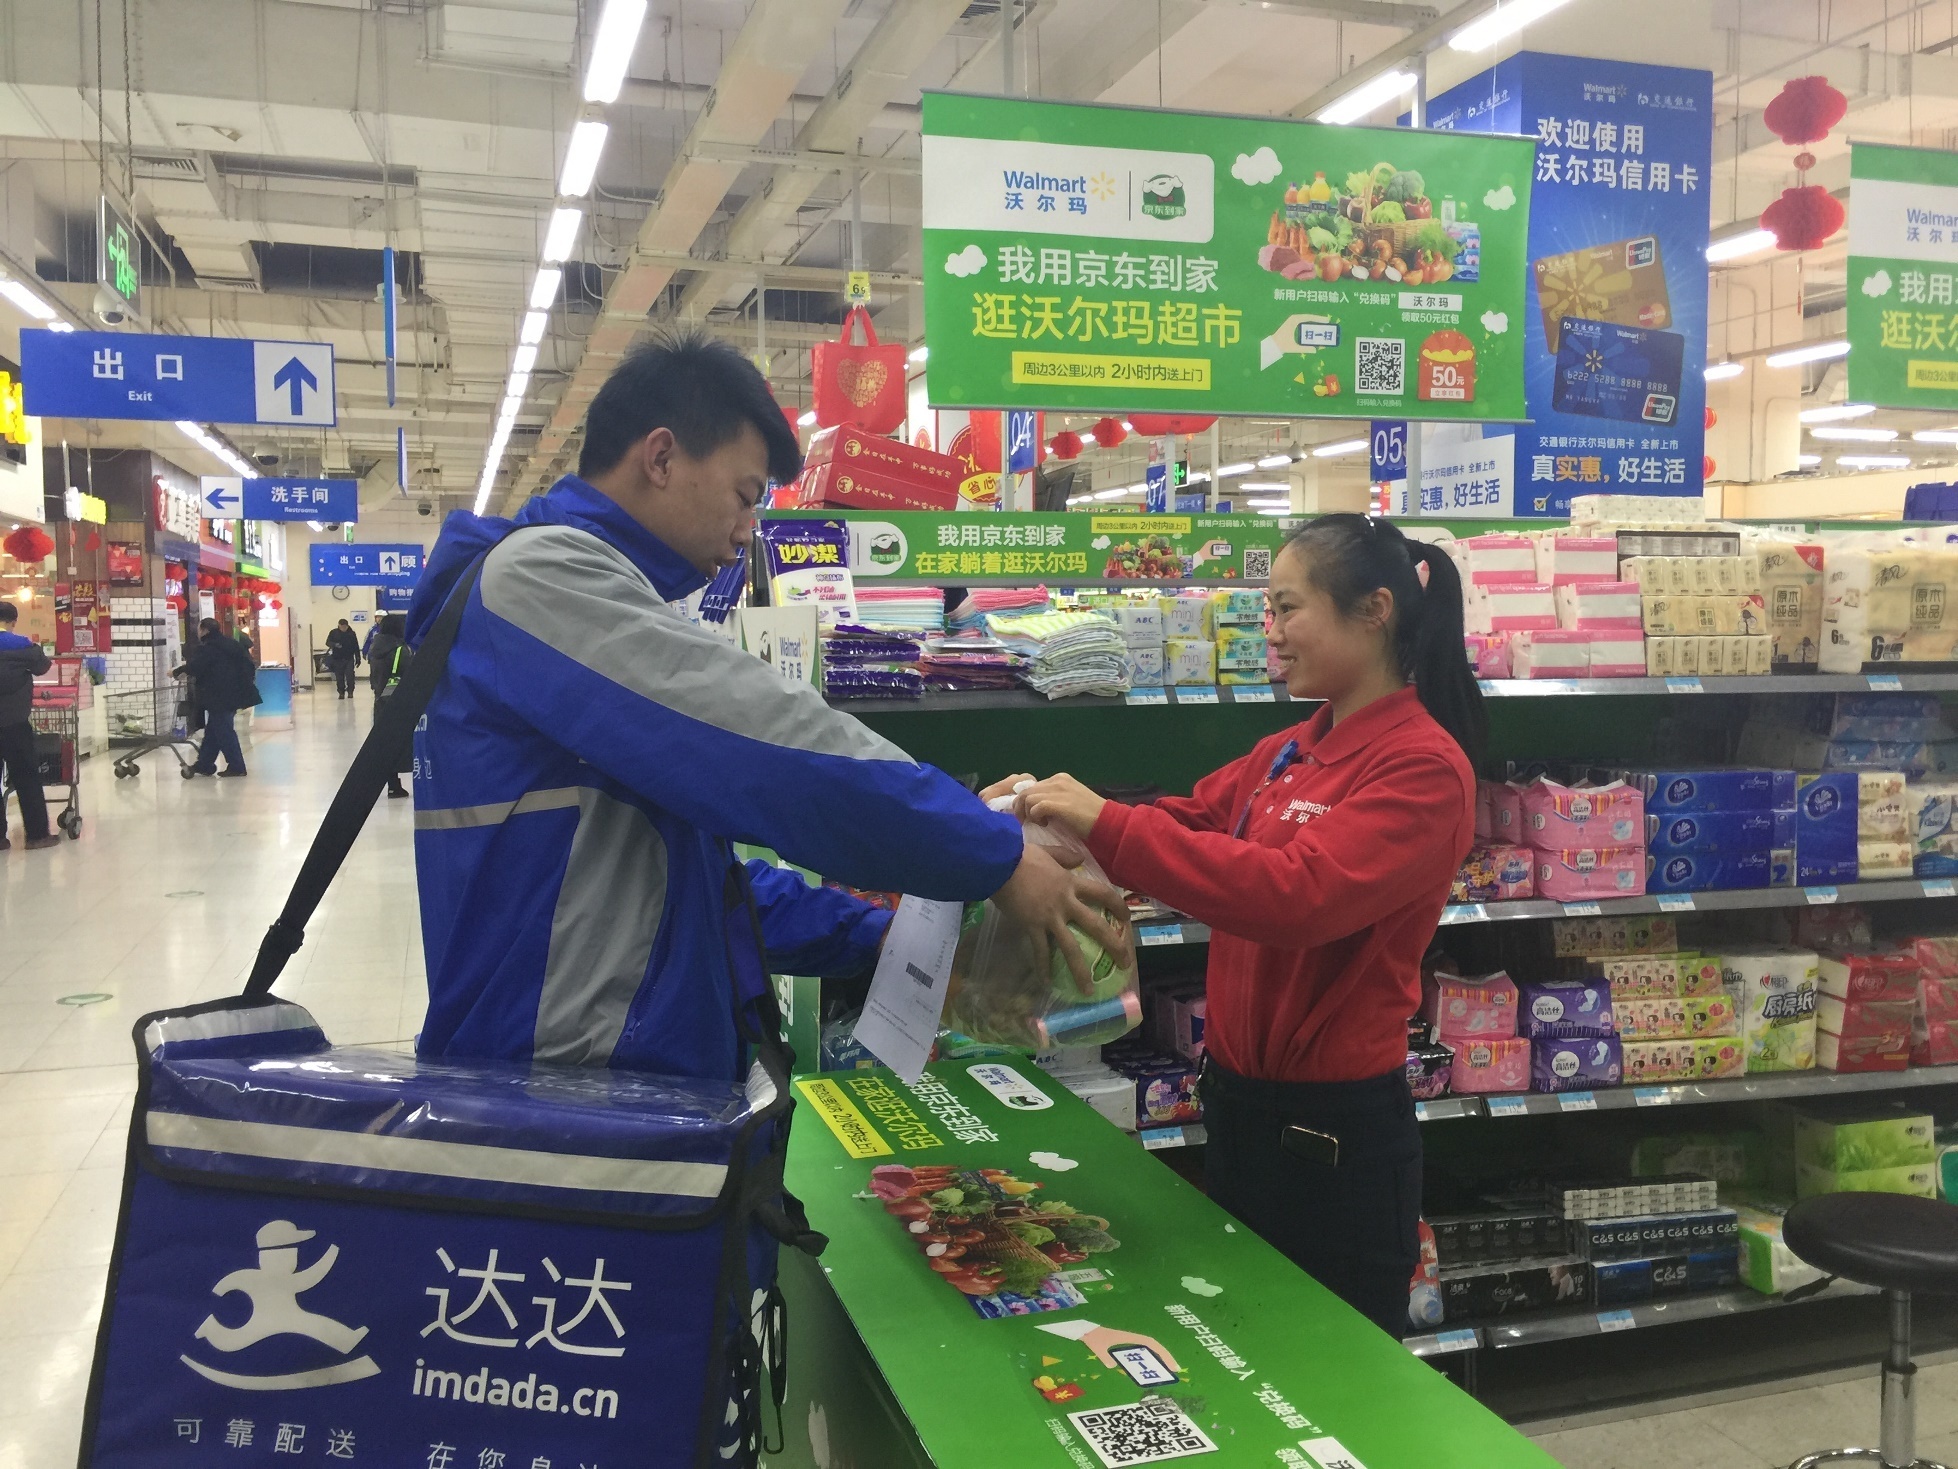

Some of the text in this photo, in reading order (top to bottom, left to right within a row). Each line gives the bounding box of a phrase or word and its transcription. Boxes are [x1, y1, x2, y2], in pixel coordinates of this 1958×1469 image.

[1583, 82, 1616, 94] Walmart
[1537, 116, 1645, 155] 欢迎使用
[1003, 170, 1087, 194] Walmart
[1536, 152, 1699, 195] 沃尔玛信用卡
[1004, 192, 1088, 215] 沃尔玛
[1142, 204, 1185, 217] 京东到家
[997, 244, 1220, 293] 我用京东到家
[1273, 287, 1350, 305] 新用户扫码输入
[1899, 270, 1958, 306] 我用
[1413, 295, 1450, 309] 沃尔玛
[971, 291, 1243, 349] 逛沃尔玛超市
[1401, 311, 1460, 325] 领取50元红包
[1304, 329, 1334, 341] 扫一扫
[93, 348, 184, 382] 出口
[1022, 361, 1204, 383] 周边3公里以内 2小时内送上门
[128, 390, 153, 402] Exit
[1374, 426, 1403, 466] 05
[1539, 436, 1679, 451] 交通银行沃尔玛信用卡 全新上市
[1420, 460, 1496, 480] 行沃尔玛信用卡 全新上市
[270, 486, 329, 504] 洗手间
[284, 506, 319, 514] Restrooms
[937, 524, 1067, 547] 我用京东到家
[340, 555, 363, 565] 出口
[915, 551, 1088, 575] 在家躺着逛沃尔玛
[1135, 616, 1154, 624] ABC
[1288, 798, 1332, 816] Walmart
[1536, 1006, 1560, 1016] 高洁丝
[1555, 1061, 1577, 1072] 高洁丝
[845, 1076, 945, 1151] 在家逛沃尔玛
[1592, 1223, 1738, 1244] C&S C&S C&S C&S C&S C&S
[1653, 1265, 1687, 1282] C&S
[419, 1246, 632, 1358] 达达
[1163, 1304, 1256, 1382] 新用户扫码输入
[1123, 1351, 1161, 1380] 扫一扫
[412, 1358, 620, 1420] imdada.cn
[173, 1416, 356, 1460] 可靠配送
